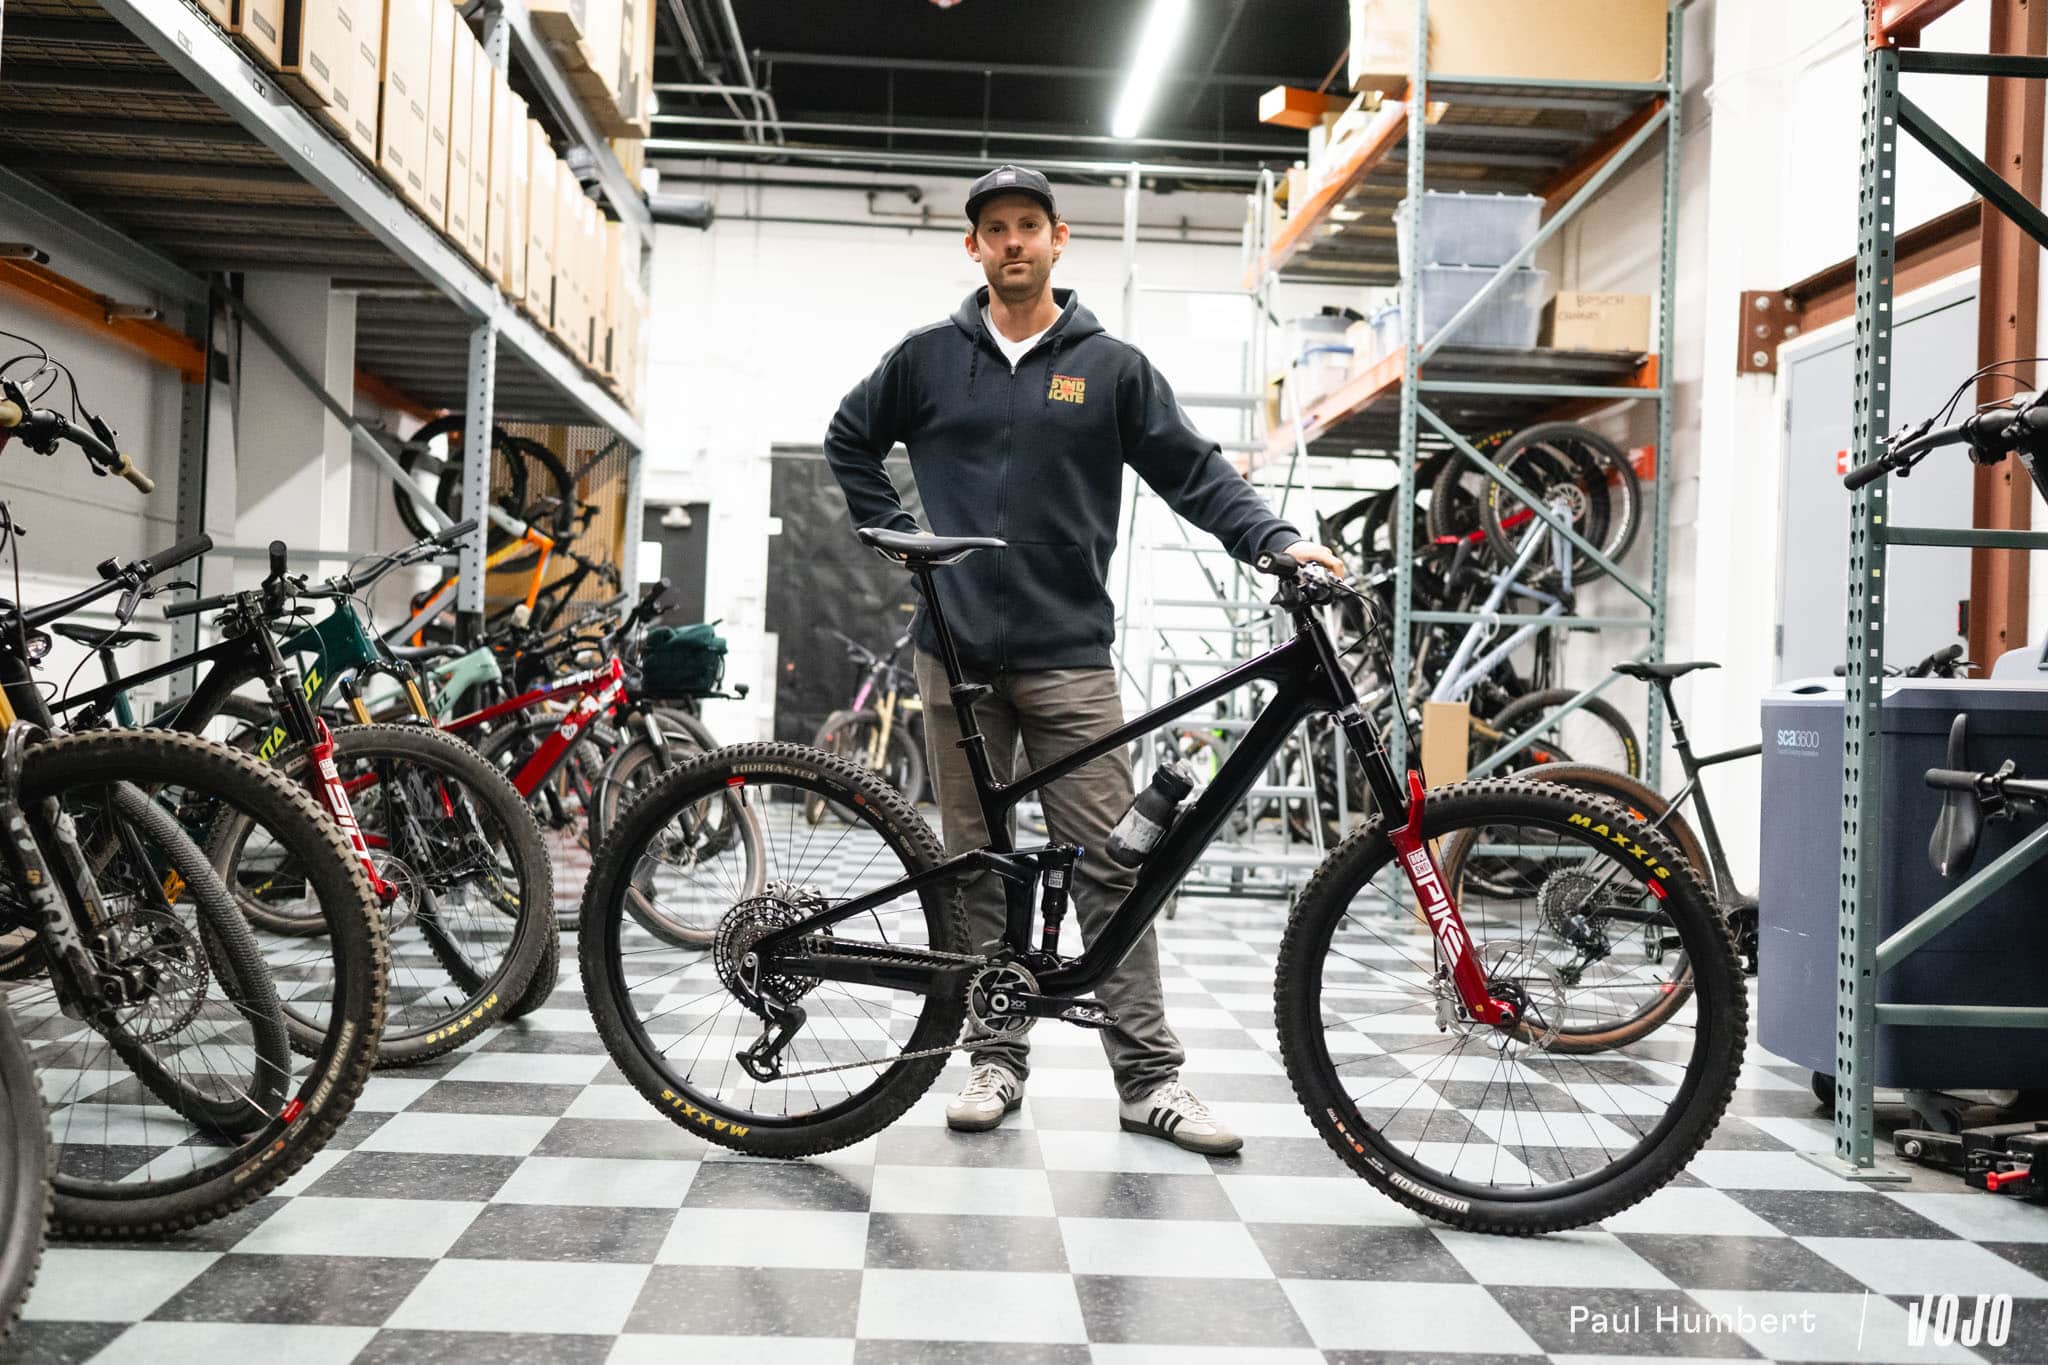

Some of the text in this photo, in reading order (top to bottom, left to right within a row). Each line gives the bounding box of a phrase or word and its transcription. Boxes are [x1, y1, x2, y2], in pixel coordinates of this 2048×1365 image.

[257, 725, 287, 761] NTA
[1567, 813, 1671, 879] MAXXIS
[1416, 872, 1464, 967] PIKE
[425, 993, 498, 1044] MAXXIS
[661, 1088, 750, 1137] MAXXIS
